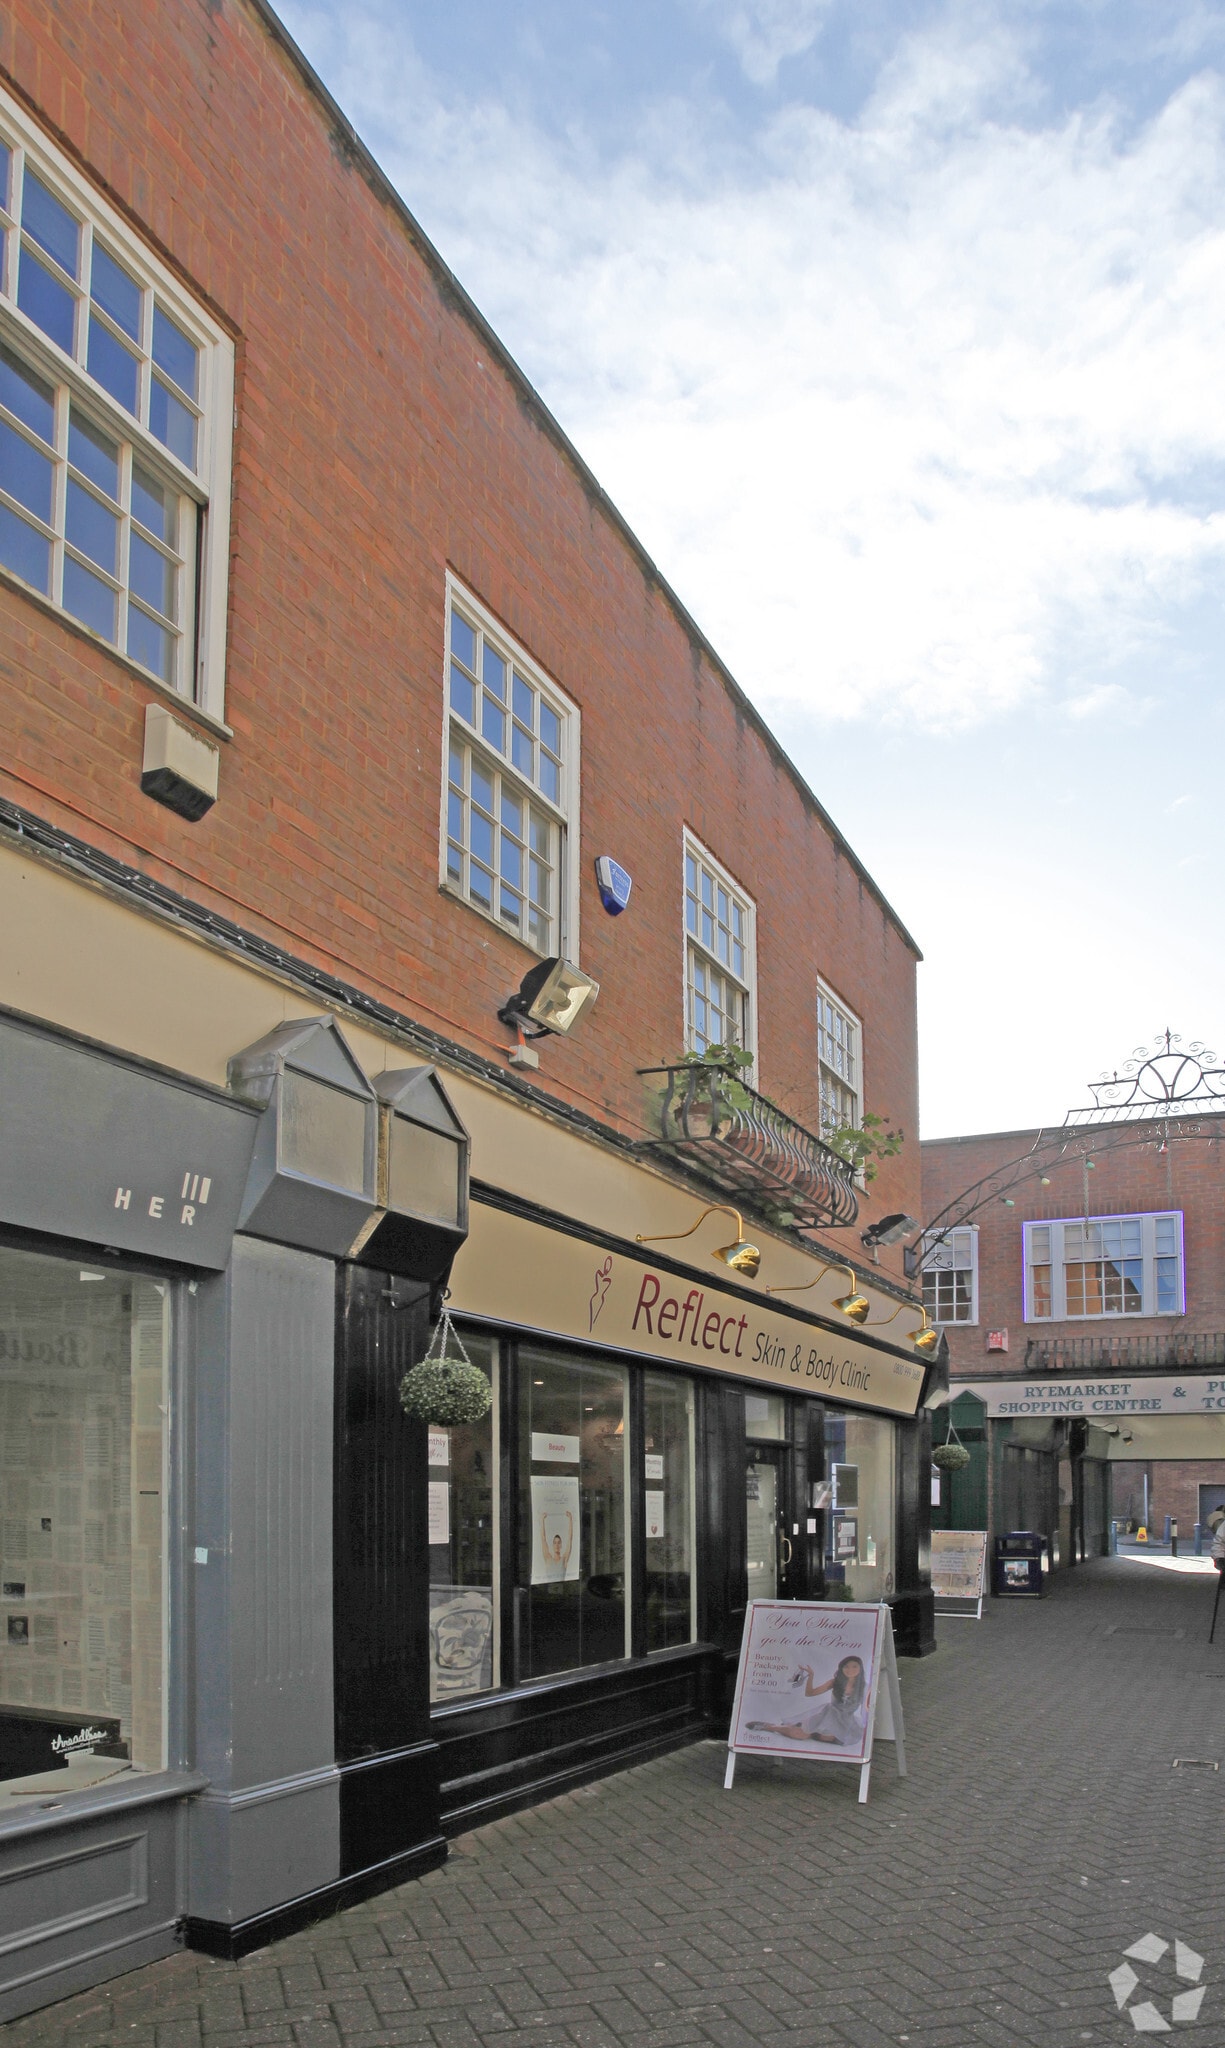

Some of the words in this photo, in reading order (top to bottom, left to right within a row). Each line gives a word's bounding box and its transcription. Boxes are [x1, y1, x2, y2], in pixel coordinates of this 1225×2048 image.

[632, 1273, 748, 1358] Reflect
[752, 1332, 786, 1369] Skin
[790, 1344, 802, 1373] &
[806, 1349, 839, 1389] Body
[840, 1359, 871, 1391] Clinic
[1024, 1383, 1132, 1398] RYEMARKET
[1172, 1386, 1187, 1398] &
[999, 1400, 1084, 1414] SHOPPING
[1092, 1398, 1162, 1412] CENTRE
[548, 1442, 566, 1453] Beauty
[766, 1612, 800, 1630] You
[805, 1616, 850, 1630] Shall
[760, 1636, 776, 1648] go
[780, 1636, 791, 1646] to
[795, 1635, 815, 1646] the
[819, 1634, 862, 1648] Prom
[755, 1653, 783, 1662] Beauty
[753, 1661, 789, 1671] Packages
[752, 1670, 772, 1678] from
[751, 1679, 778, 1687] £29.00
